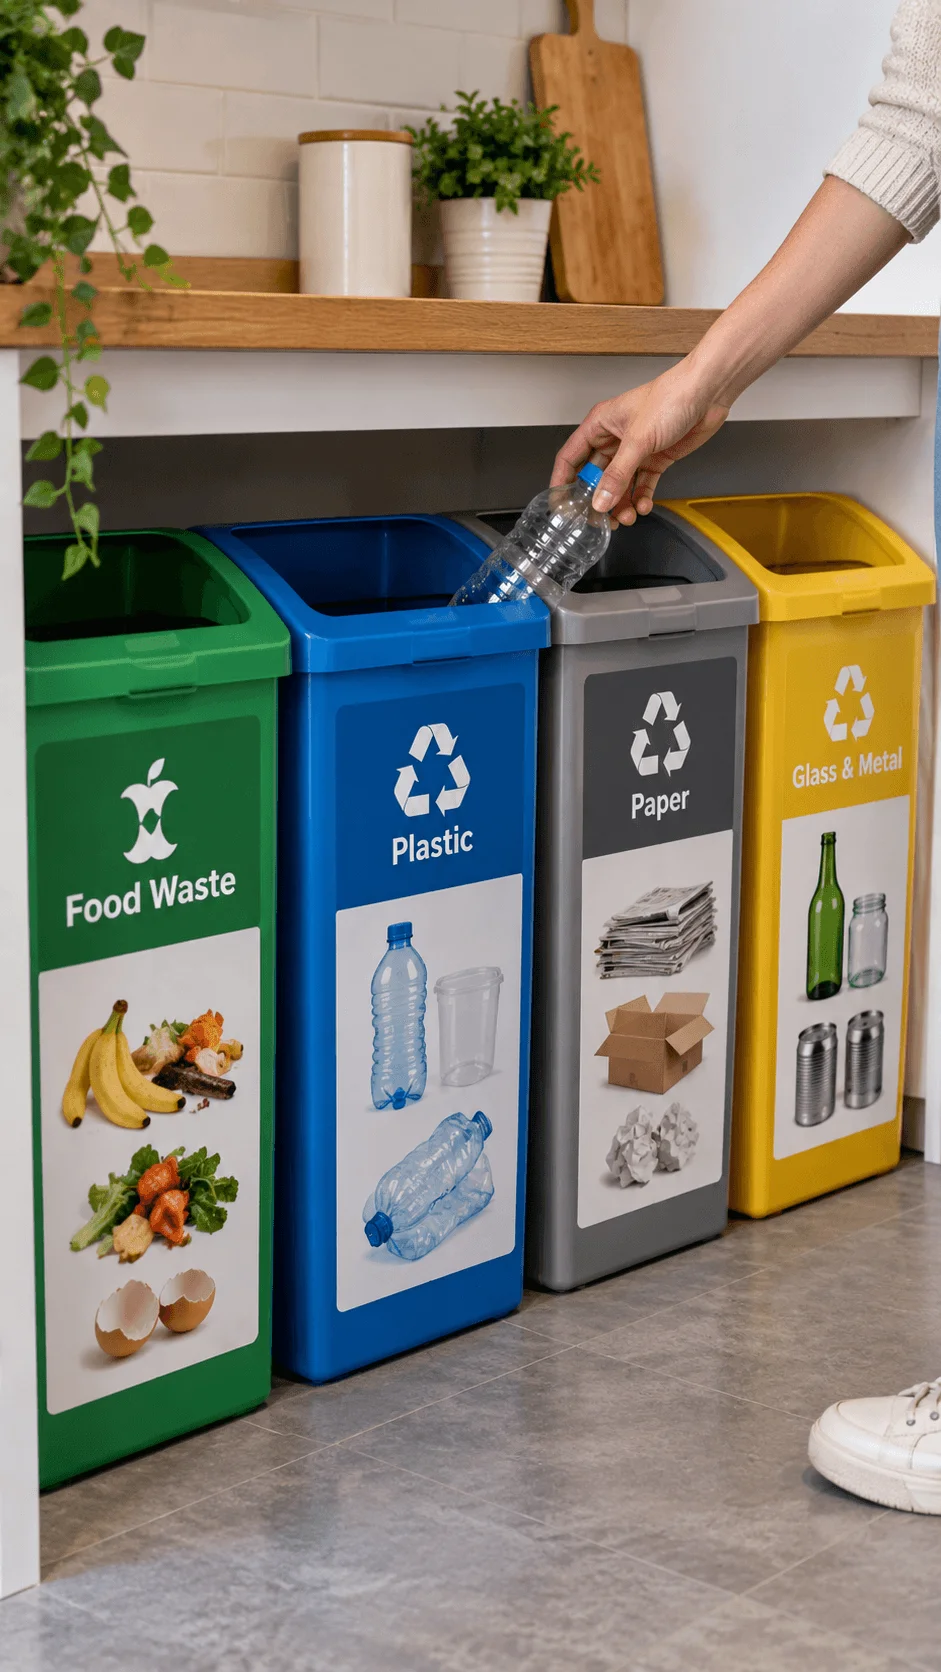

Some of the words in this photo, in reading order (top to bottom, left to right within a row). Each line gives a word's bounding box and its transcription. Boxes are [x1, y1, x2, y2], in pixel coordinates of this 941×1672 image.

[792, 763, 837, 789] Glass
[842, 758, 854, 779] &
[859, 746, 903, 776] Metal
[631, 789, 690, 821] Paper
[392, 825, 474, 866] Plastic
[66, 881, 141, 927] Food
[149, 869, 236, 909] Waste
